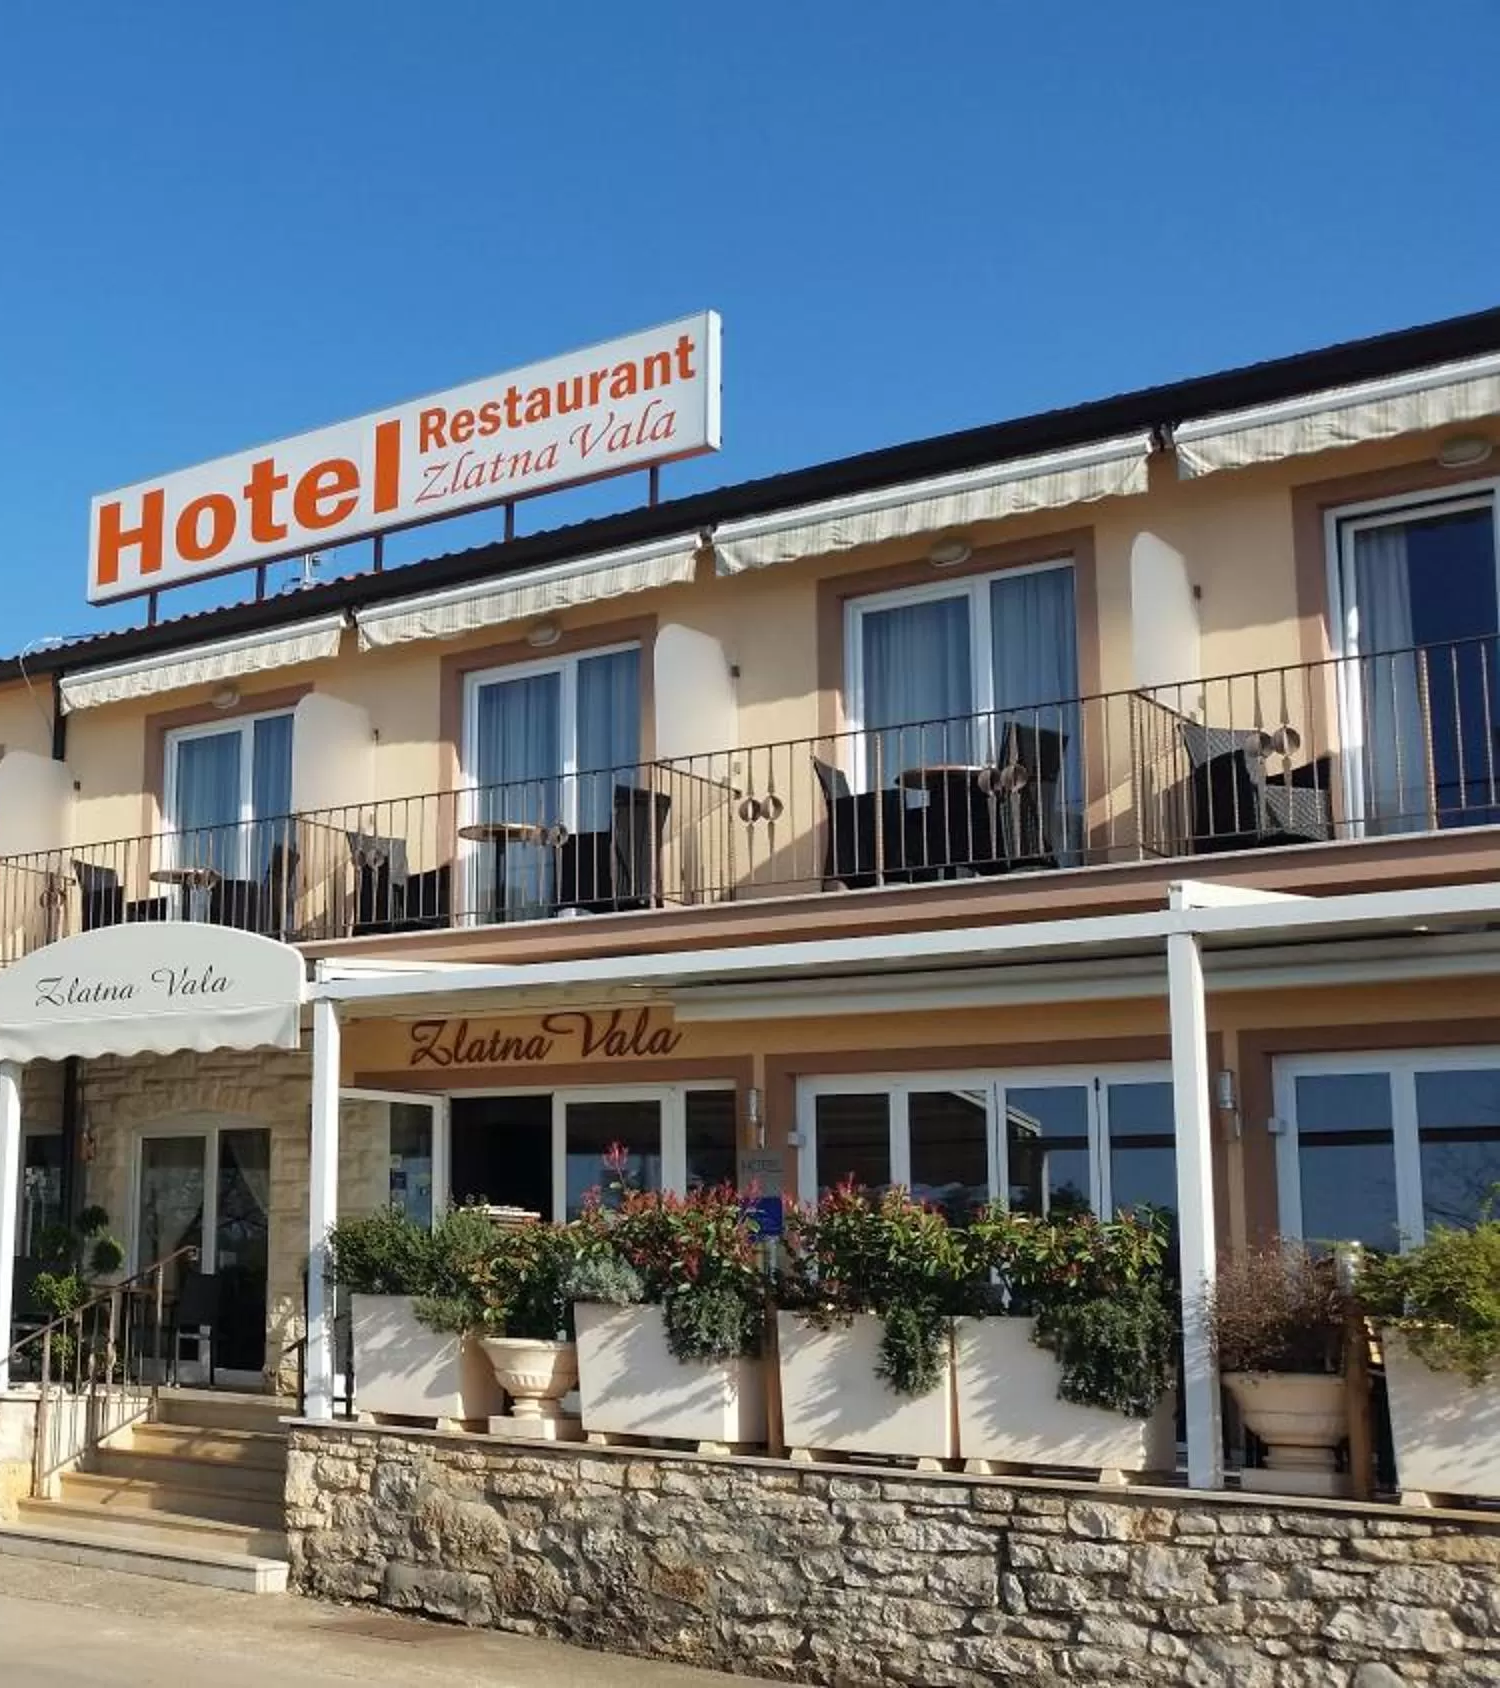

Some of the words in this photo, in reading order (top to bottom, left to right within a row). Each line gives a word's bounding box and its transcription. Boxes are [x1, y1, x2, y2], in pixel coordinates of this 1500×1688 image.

[419, 335, 696, 454] Restaurant
[414, 451, 559, 504] Zlatna
[569, 399, 677, 460] Vala
[96, 437, 402, 585] Hotel
[35, 976, 135, 1006] Zlatna
[151, 965, 231, 997] Vala
[411, 1018, 554, 1066] Zlatna
[541, 1007, 682, 1057] Vala
